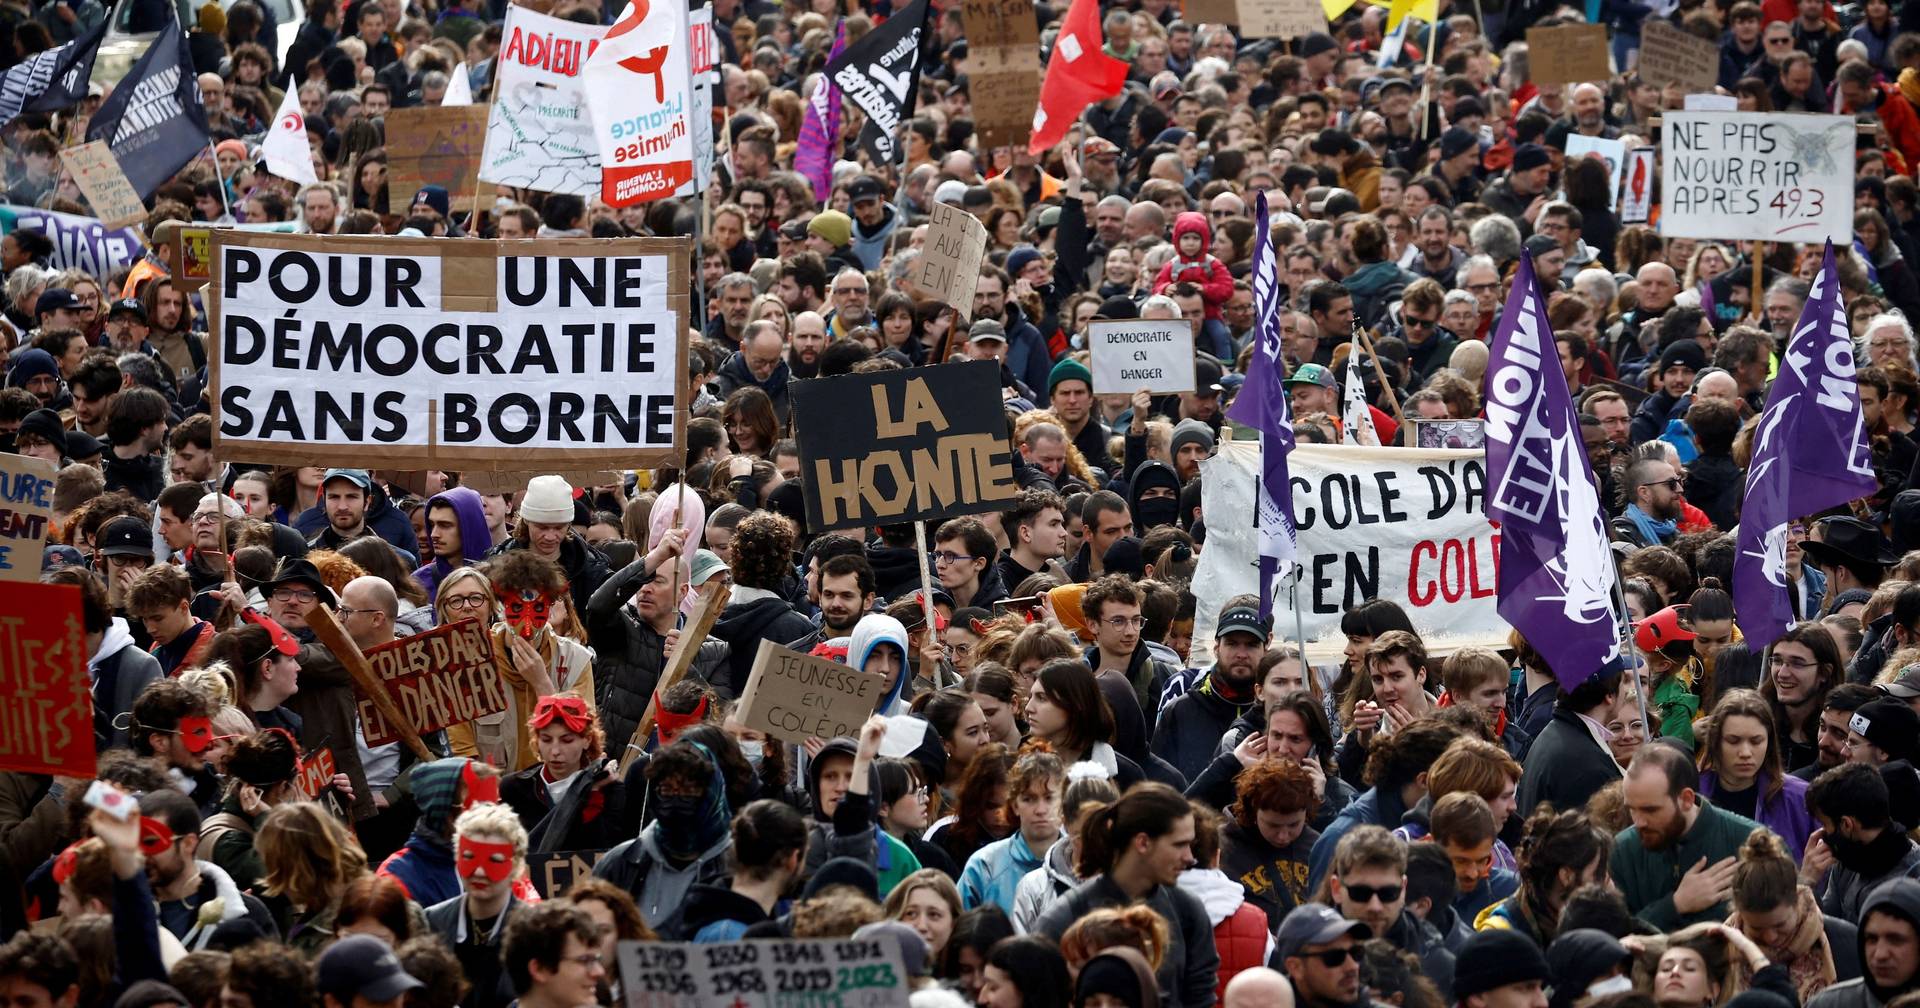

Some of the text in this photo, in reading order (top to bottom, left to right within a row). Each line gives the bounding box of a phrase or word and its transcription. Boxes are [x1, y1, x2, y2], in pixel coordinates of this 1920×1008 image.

[506, 26, 582, 77] ADIEU
[1673, 122, 1776, 153] NE PAS
[932, 206, 952, 227] LA
[1770, 188, 1824, 219] 49.3
[225, 248, 425, 308] POUR
[504, 257, 642, 308] UNE
[922, 262, 951, 293] EN
[224, 309, 656, 376] DÉMOCRATIE
[1133, 350, 1147, 361] EN
[1121, 368, 1162, 380] DANGER
[220, 385, 674, 446] SANS BORNE
[870, 376, 949, 440] LA
[0, 471, 55, 507] URE
[815, 432, 1016, 525] HONTE
[1253, 471, 1407, 531] COLE
[1312, 545, 1379, 614] EN
[0, 617, 65, 698] TES
[775, 655, 870, 697] JEUNESSE
[399, 662, 506, 733] DANGER
[801, 692, 833, 711] EN
[703, 944, 759, 968] 1830
[833, 941, 883, 962] 1871
[710, 970, 767, 996] 1968
[773, 967, 832, 992] 2019
[836, 963, 898, 991] 2023
